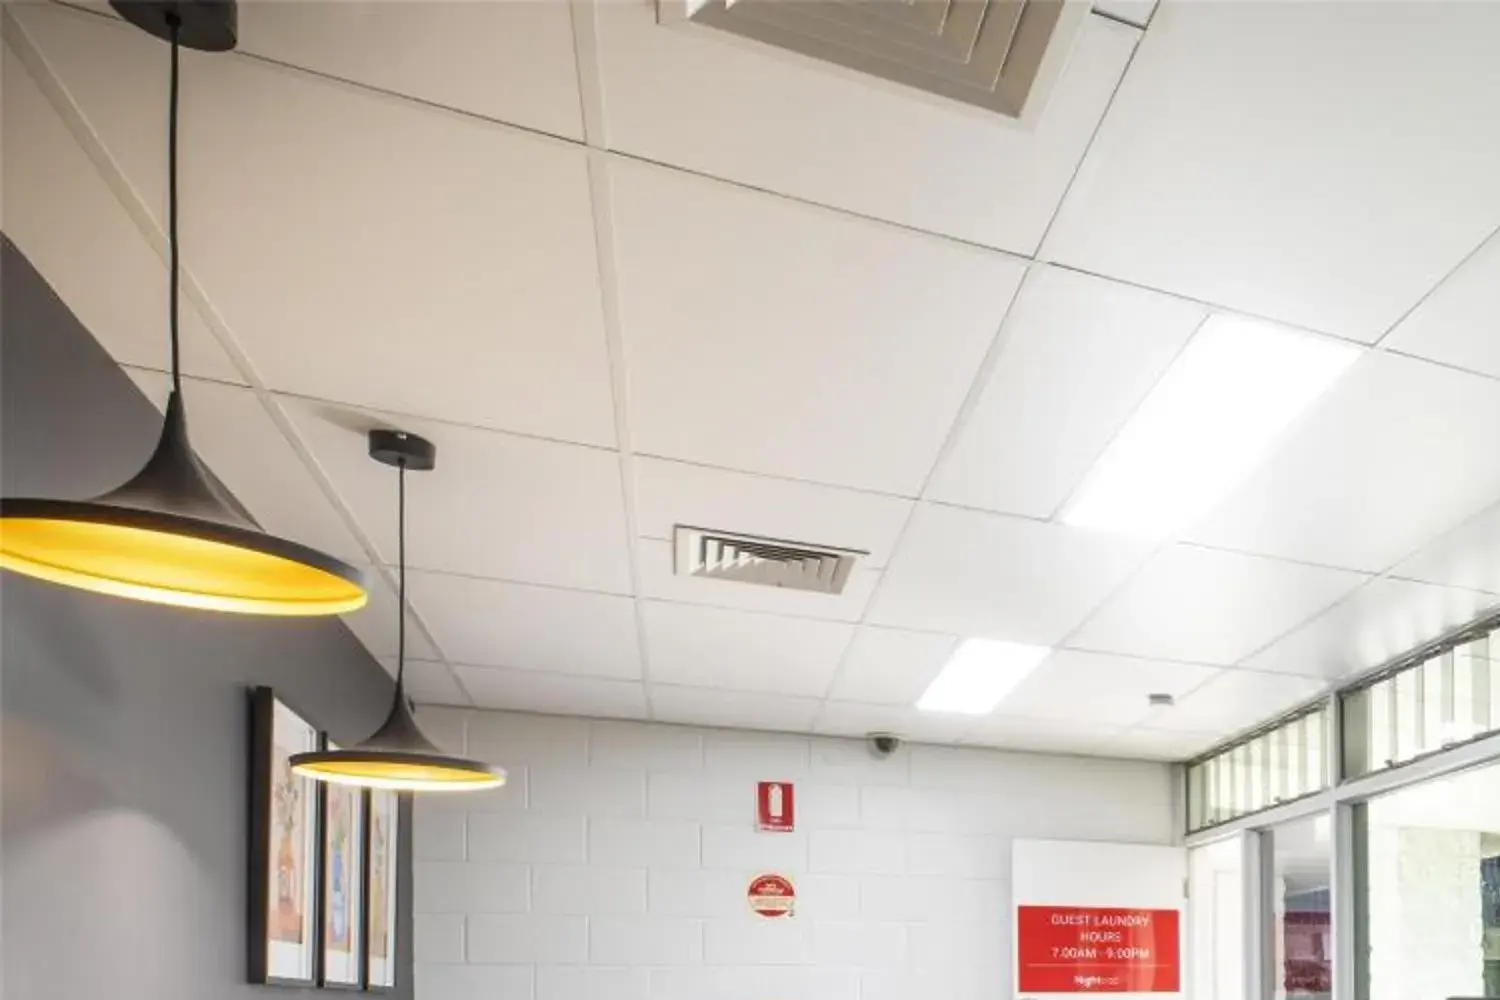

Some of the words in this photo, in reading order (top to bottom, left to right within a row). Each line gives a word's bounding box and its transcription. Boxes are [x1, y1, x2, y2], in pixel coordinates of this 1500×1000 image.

[1051, 913, 1089, 926] GUEST
[1094, 914, 1150, 928] LAUNDRY
[1080, 931, 1121, 943] HOURS
